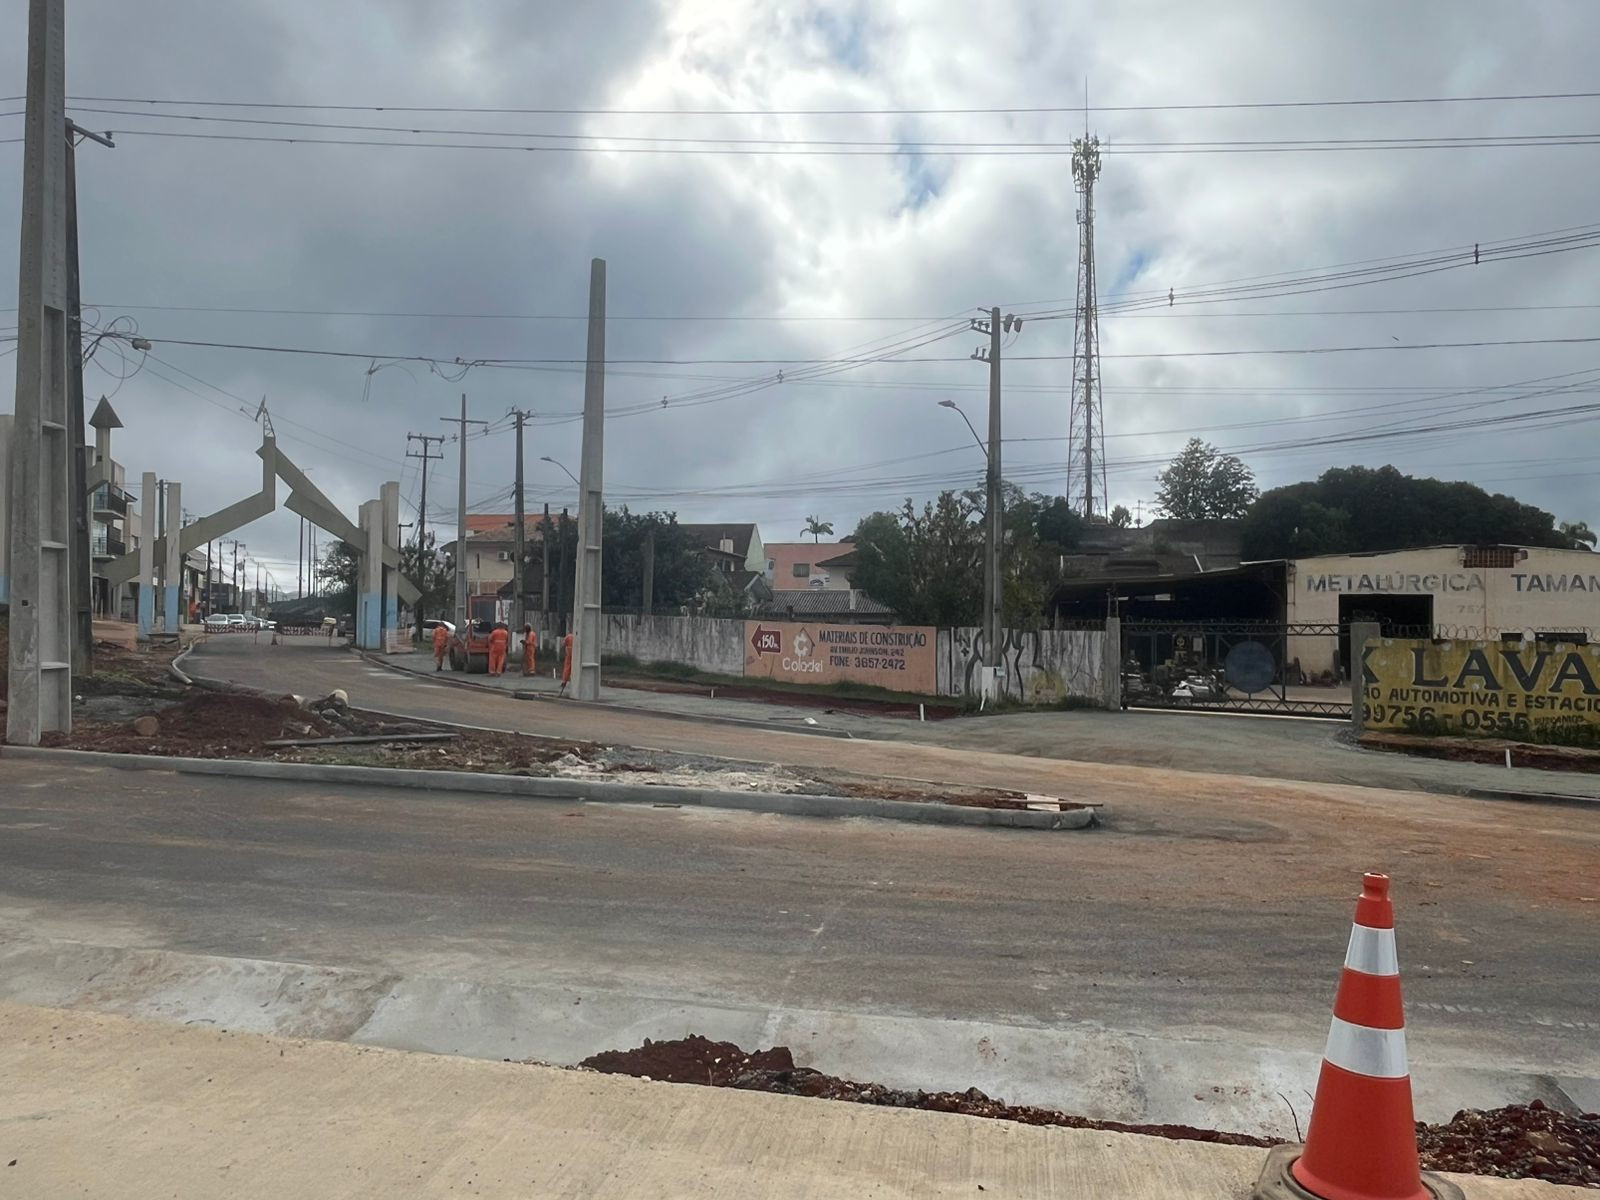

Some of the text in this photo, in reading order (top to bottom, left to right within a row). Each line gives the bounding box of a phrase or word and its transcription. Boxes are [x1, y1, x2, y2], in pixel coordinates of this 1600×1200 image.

[819, 630, 927, 648] MATERIAIS DE CONSTRUÇÃO
[1389, 687, 1499, 707] AUTOMOTIVA
[1507, 693, 1517, 708] E
